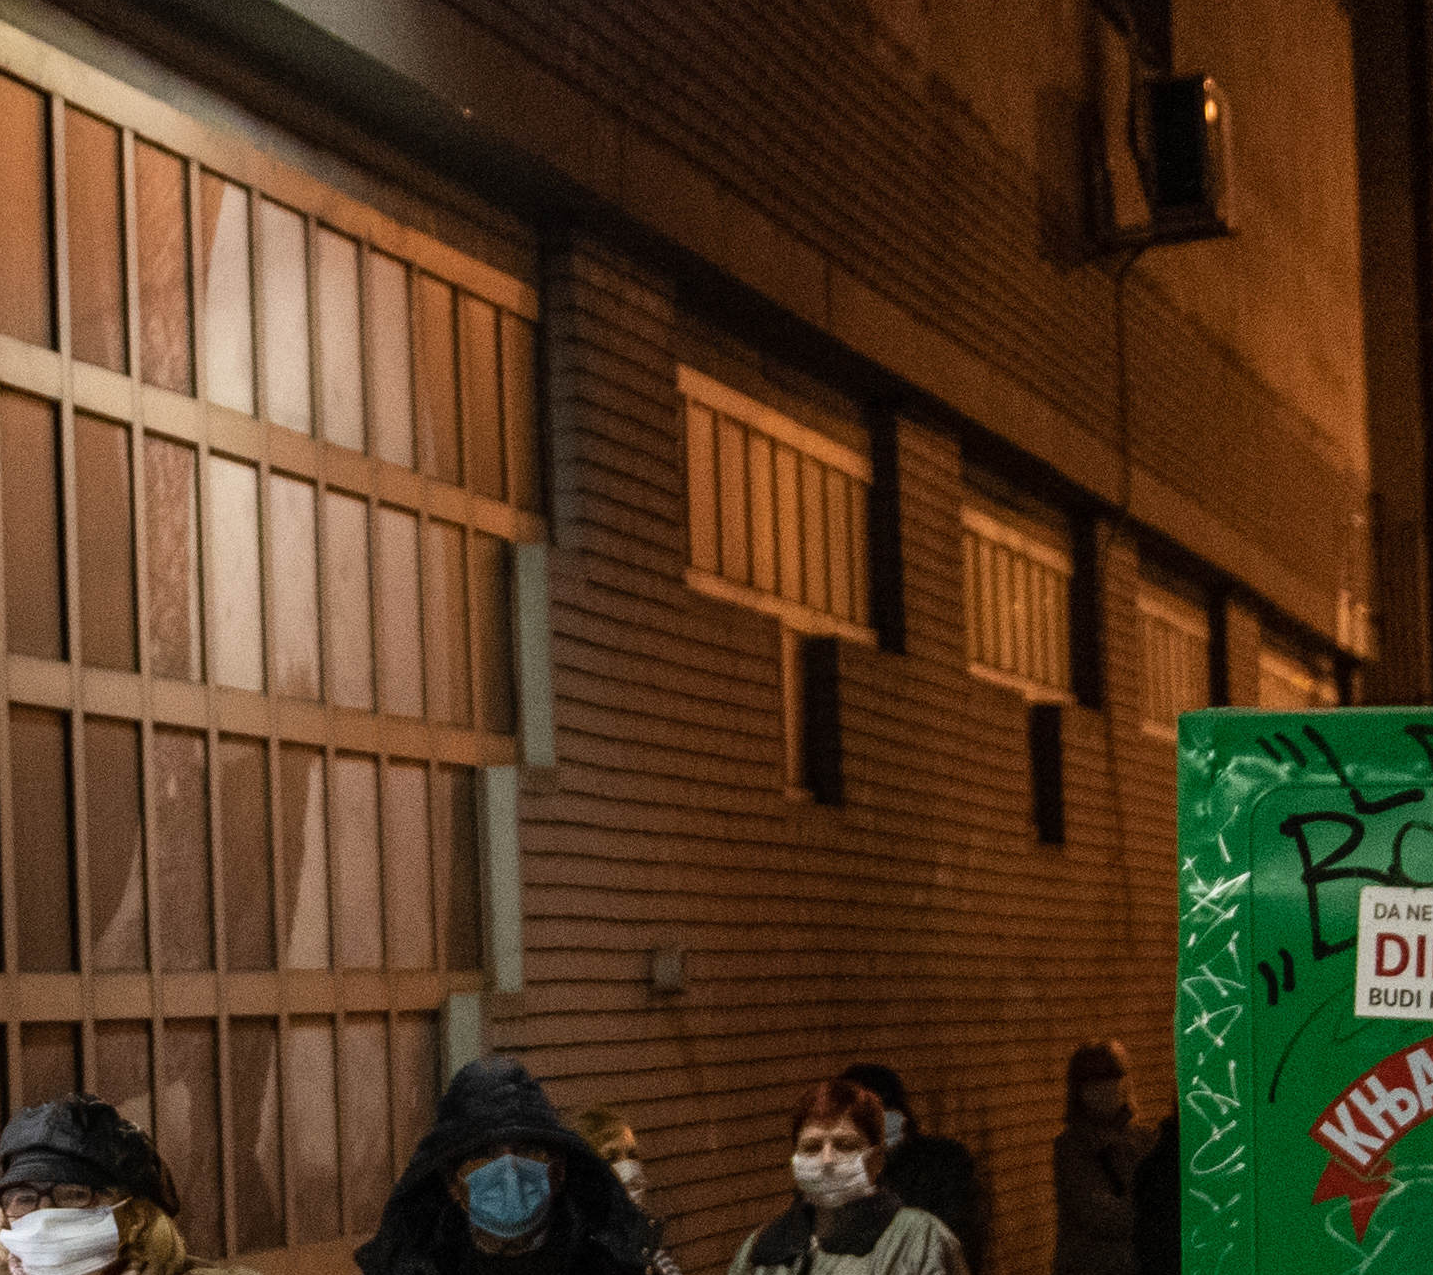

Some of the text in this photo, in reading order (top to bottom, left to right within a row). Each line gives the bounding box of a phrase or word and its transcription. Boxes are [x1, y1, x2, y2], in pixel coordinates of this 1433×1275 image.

[1373, 902, 1401, 921] DA
[1406, 903, 1433, 922] NE
[1368, 987, 1422, 1009] BUDI
